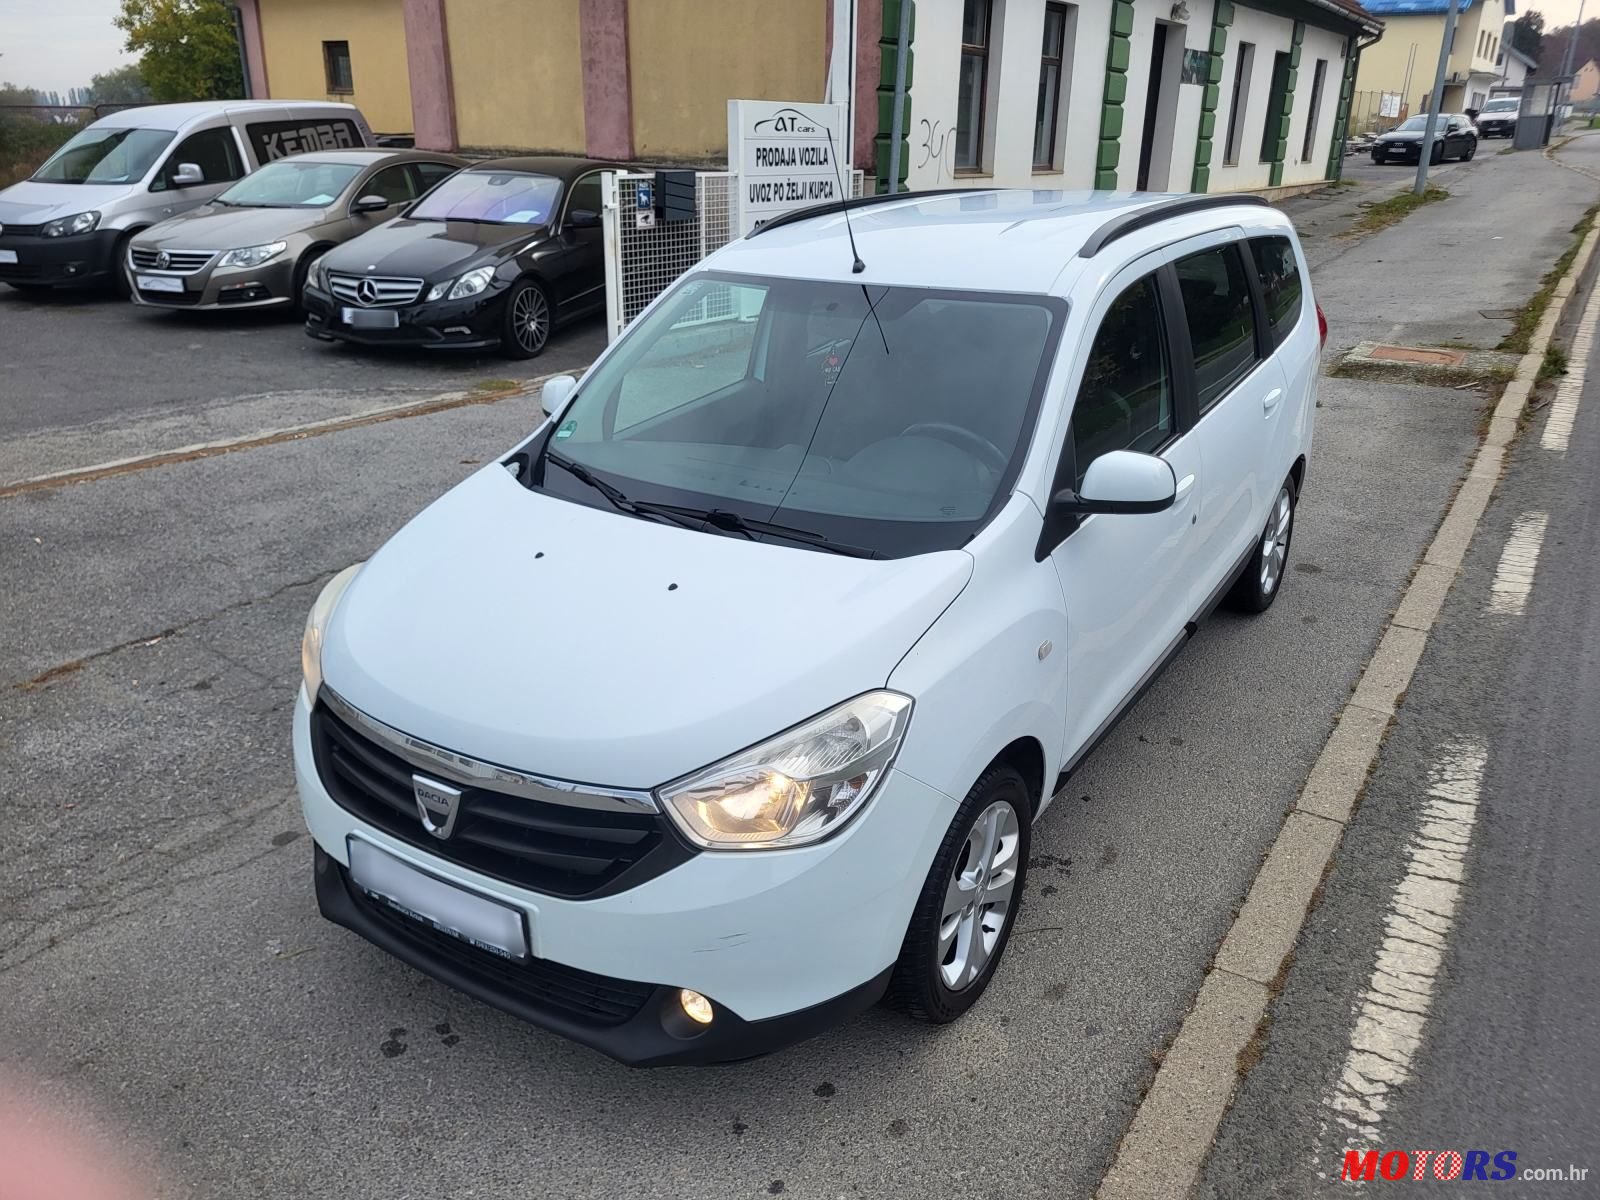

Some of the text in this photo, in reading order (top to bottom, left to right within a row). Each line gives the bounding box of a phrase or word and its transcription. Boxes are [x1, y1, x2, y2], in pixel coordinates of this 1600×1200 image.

[774, 116, 798, 132] AT
[262, 122, 353, 160] KEMBA
[755, 147, 829, 167] PRODAJA VOZILA
[749, 177, 834, 203] UVOZ PO ŽELJI KUPCA
[417, 787, 450, 807] DACIA
